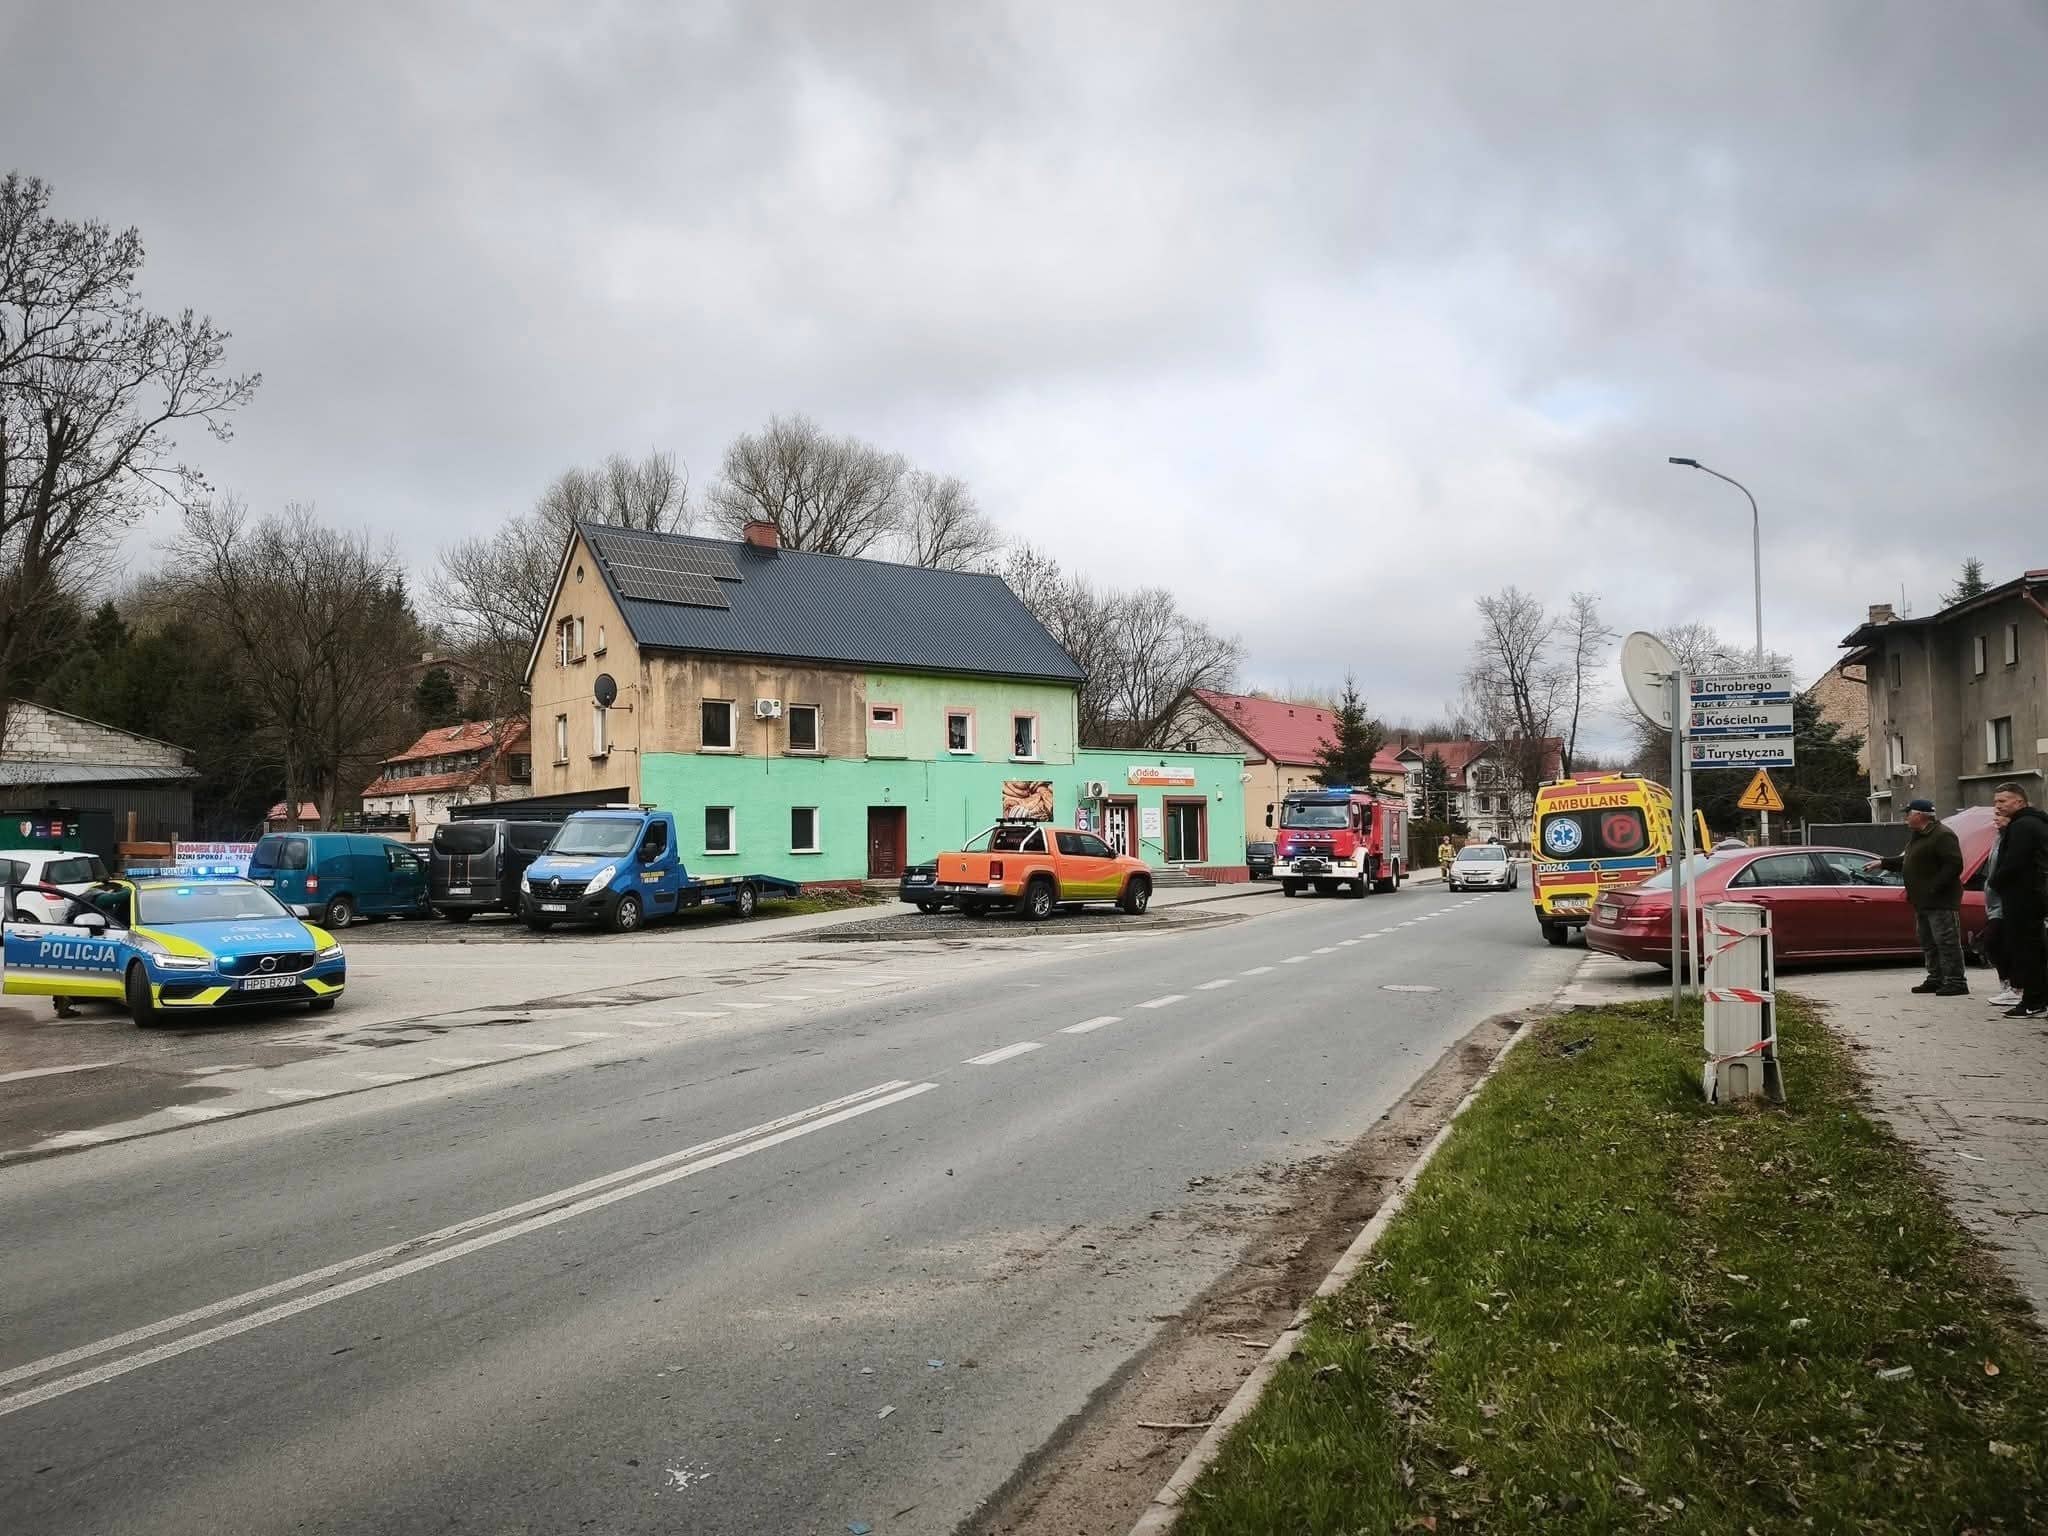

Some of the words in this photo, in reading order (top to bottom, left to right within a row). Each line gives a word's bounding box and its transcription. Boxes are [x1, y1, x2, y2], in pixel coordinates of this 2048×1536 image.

[1705, 681, 1772, 693] Chrobrego
[1706, 714, 1768, 726] Kościelna
[1707, 748, 1785, 760] Turystyczna
[1136, 768, 1160, 777] Odido
[1548, 794, 1629, 811] AMBULANS
[177, 844, 210, 853] DOMEK
[213, 844, 226, 853] NA
[161, 868, 192, 876] POLICJA
[222, 932, 296, 942] POLICJA
[40, 941, 116, 962] POLICJA
[246, 979, 267, 990] HPB
